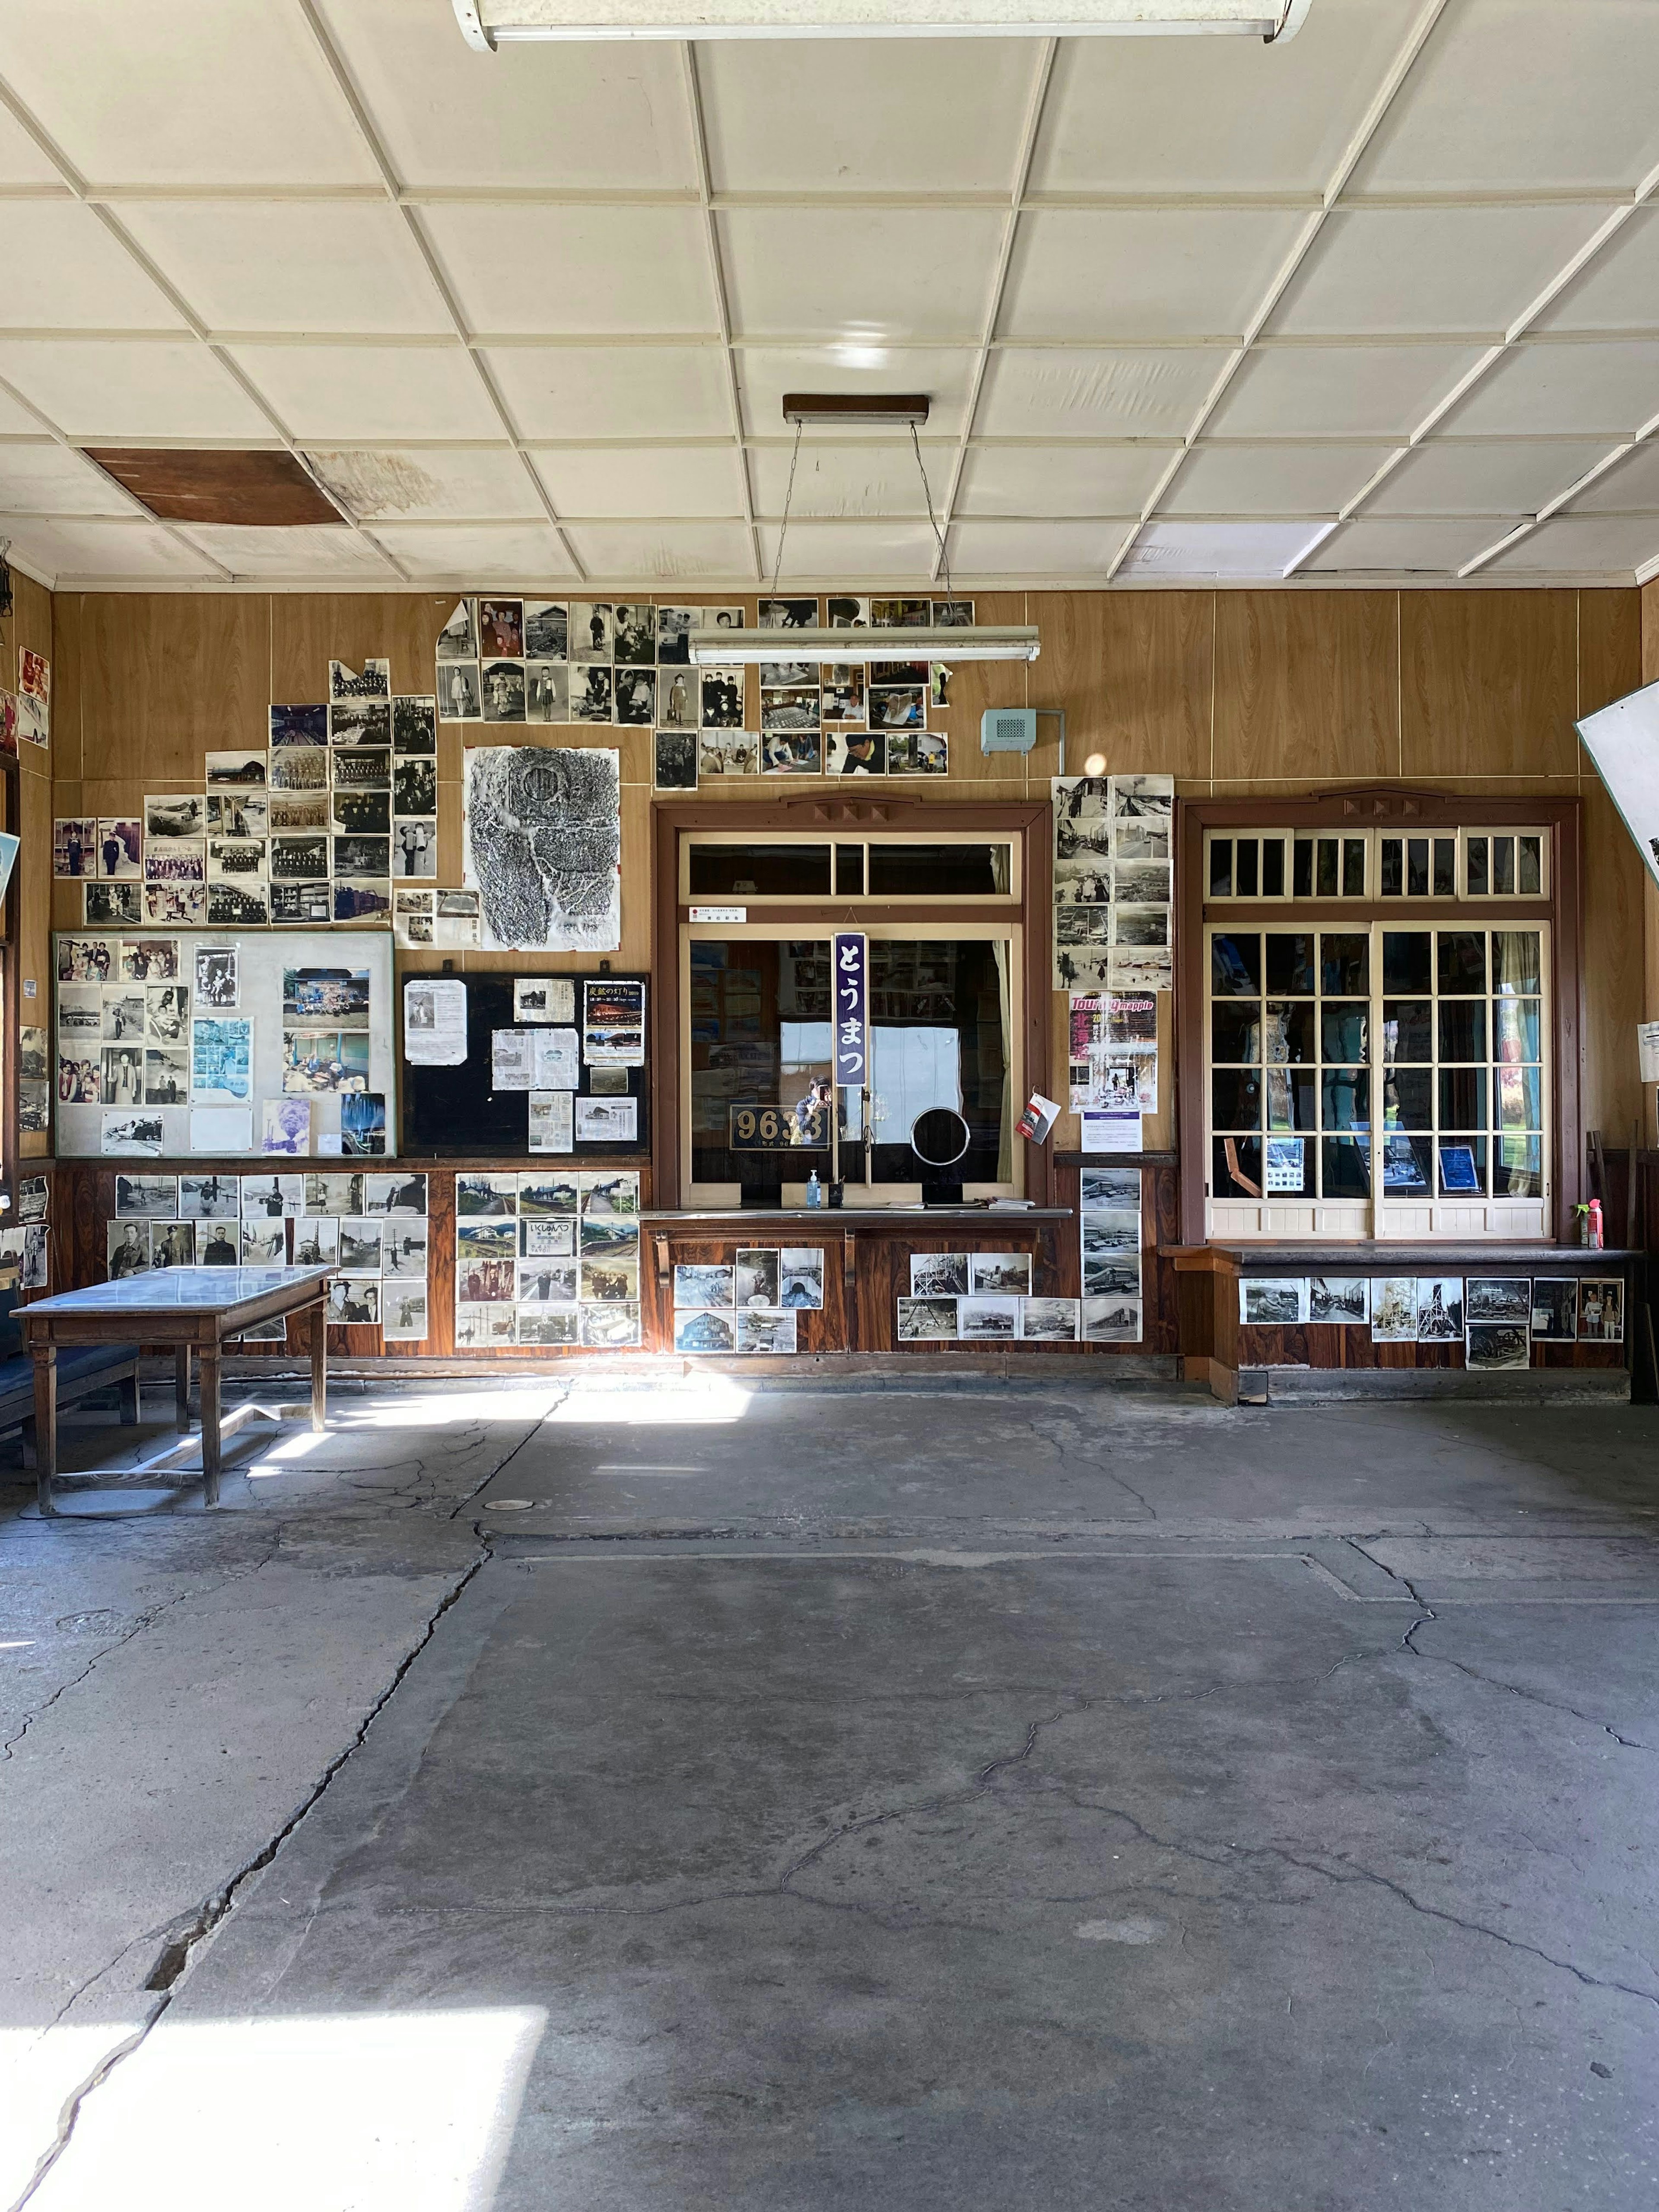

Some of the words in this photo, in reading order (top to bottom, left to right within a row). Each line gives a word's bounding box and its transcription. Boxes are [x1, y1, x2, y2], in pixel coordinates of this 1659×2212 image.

[839, 945, 863, 1074] とうまつ
[1119, 1001, 1154, 1012] mapple
